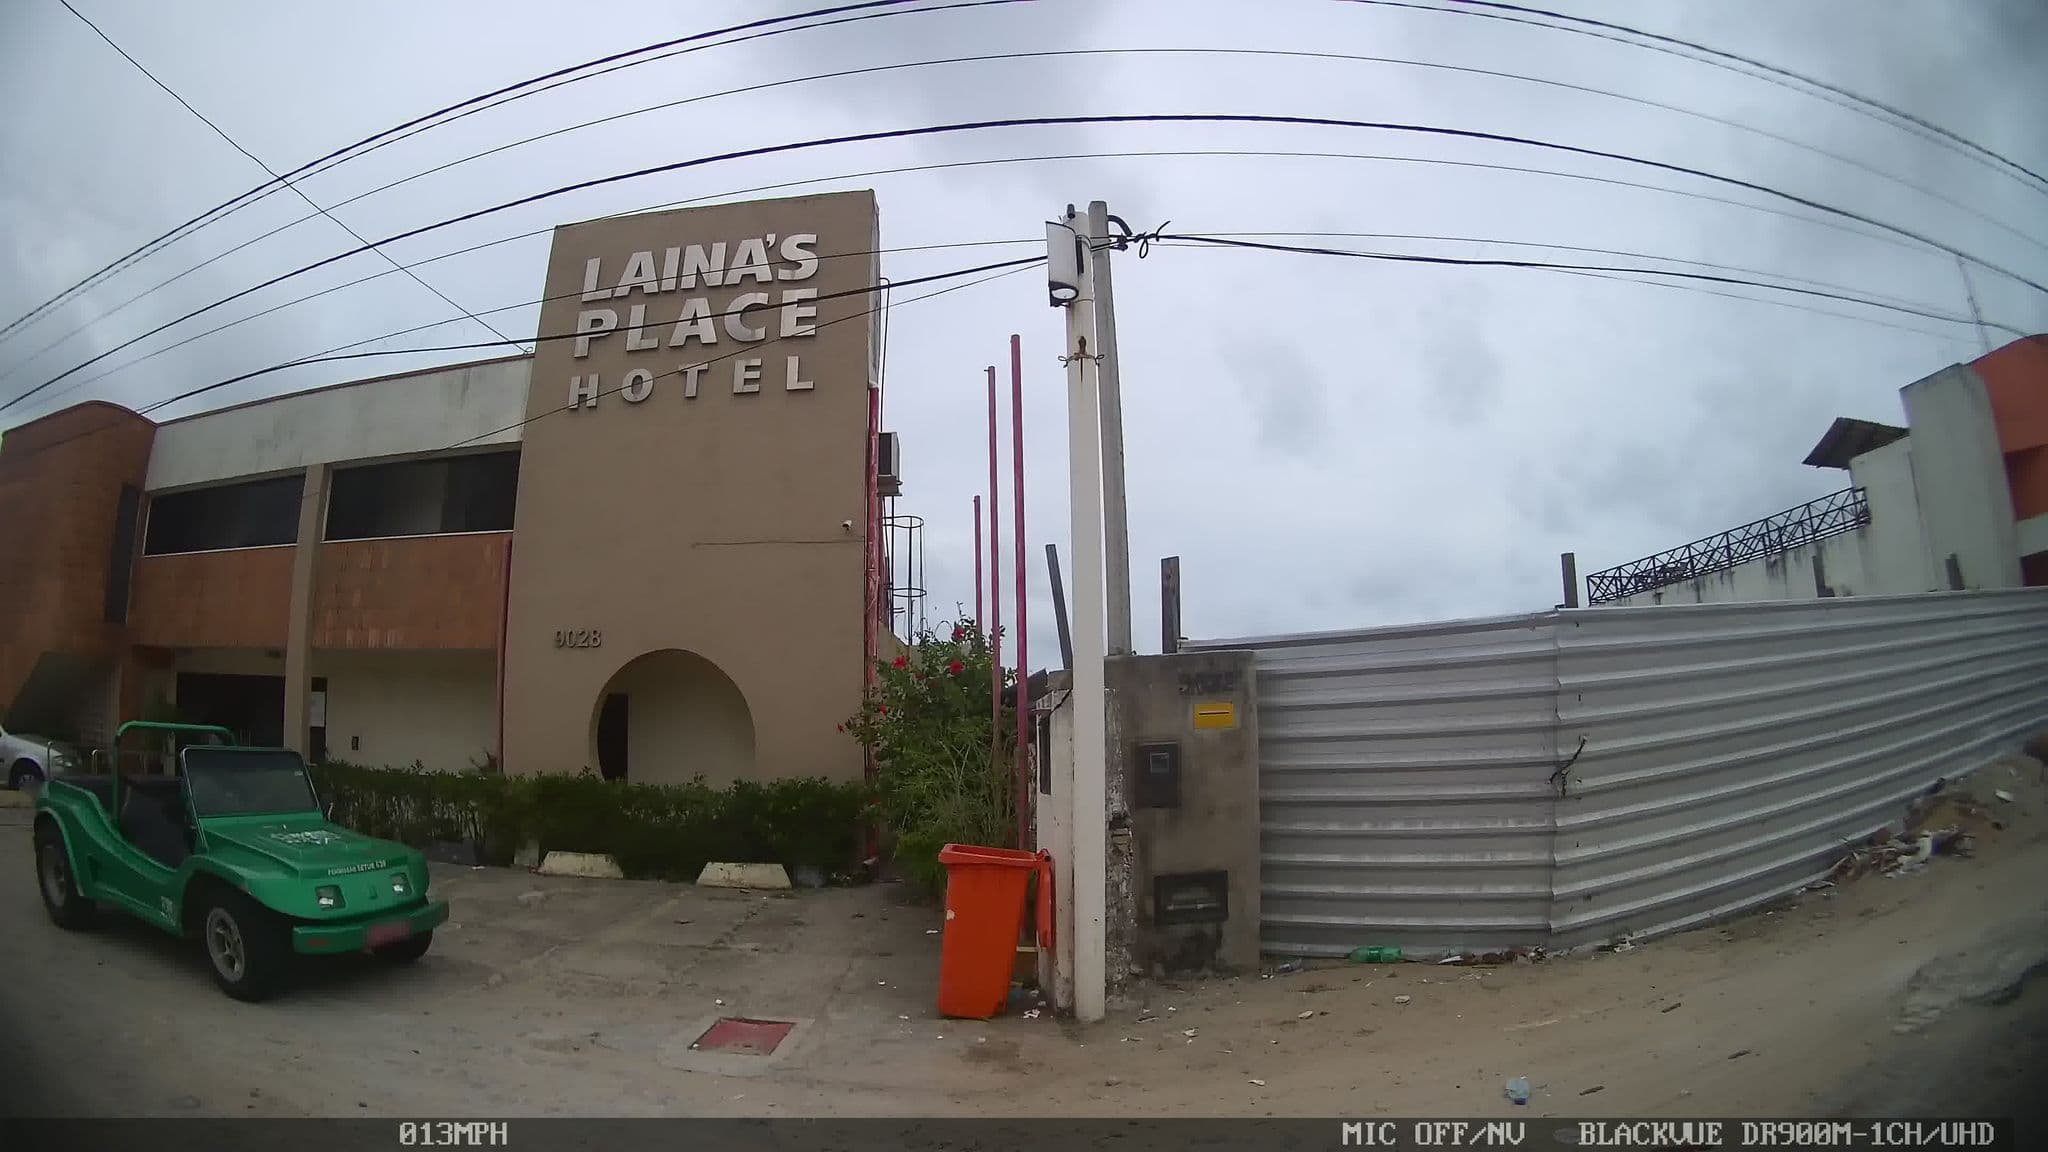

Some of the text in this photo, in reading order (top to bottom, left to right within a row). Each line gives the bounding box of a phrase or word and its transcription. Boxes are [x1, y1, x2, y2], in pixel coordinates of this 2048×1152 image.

[581, 233, 819, 303] LAINA'S
[573, 287, 819, 359] PLACE
[568, 355, 815, 409] HOTEL
[553, 629, 602, 649] 9028
